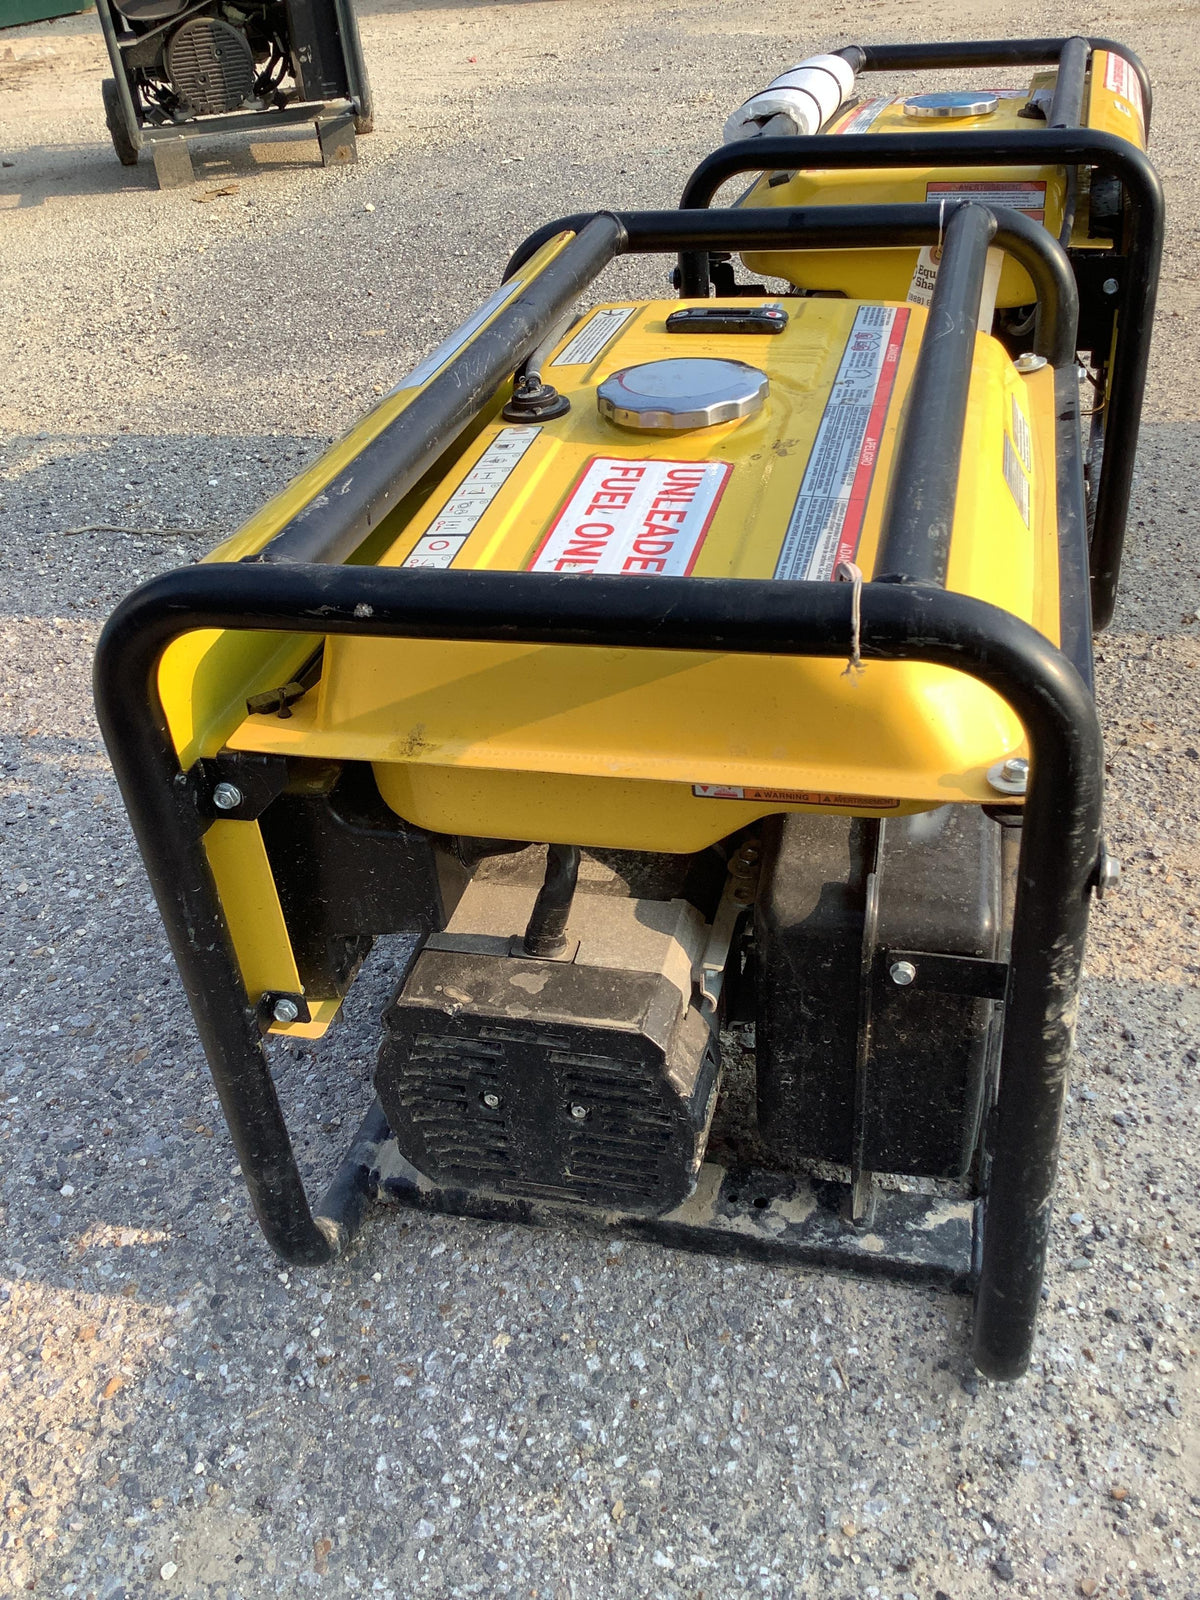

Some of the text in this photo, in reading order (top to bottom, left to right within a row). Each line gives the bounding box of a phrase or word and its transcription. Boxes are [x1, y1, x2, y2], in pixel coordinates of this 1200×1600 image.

[918, 265, 936, 280] Equ
[915, 277, 934, 291] Sha
[860, 442, 875, 465] PELIGRO
[553, 466, 646, 575] FUEL ONL
[619, 468, 706, 576] UNLEADE
[763, 791, 809, 801] WARNING
